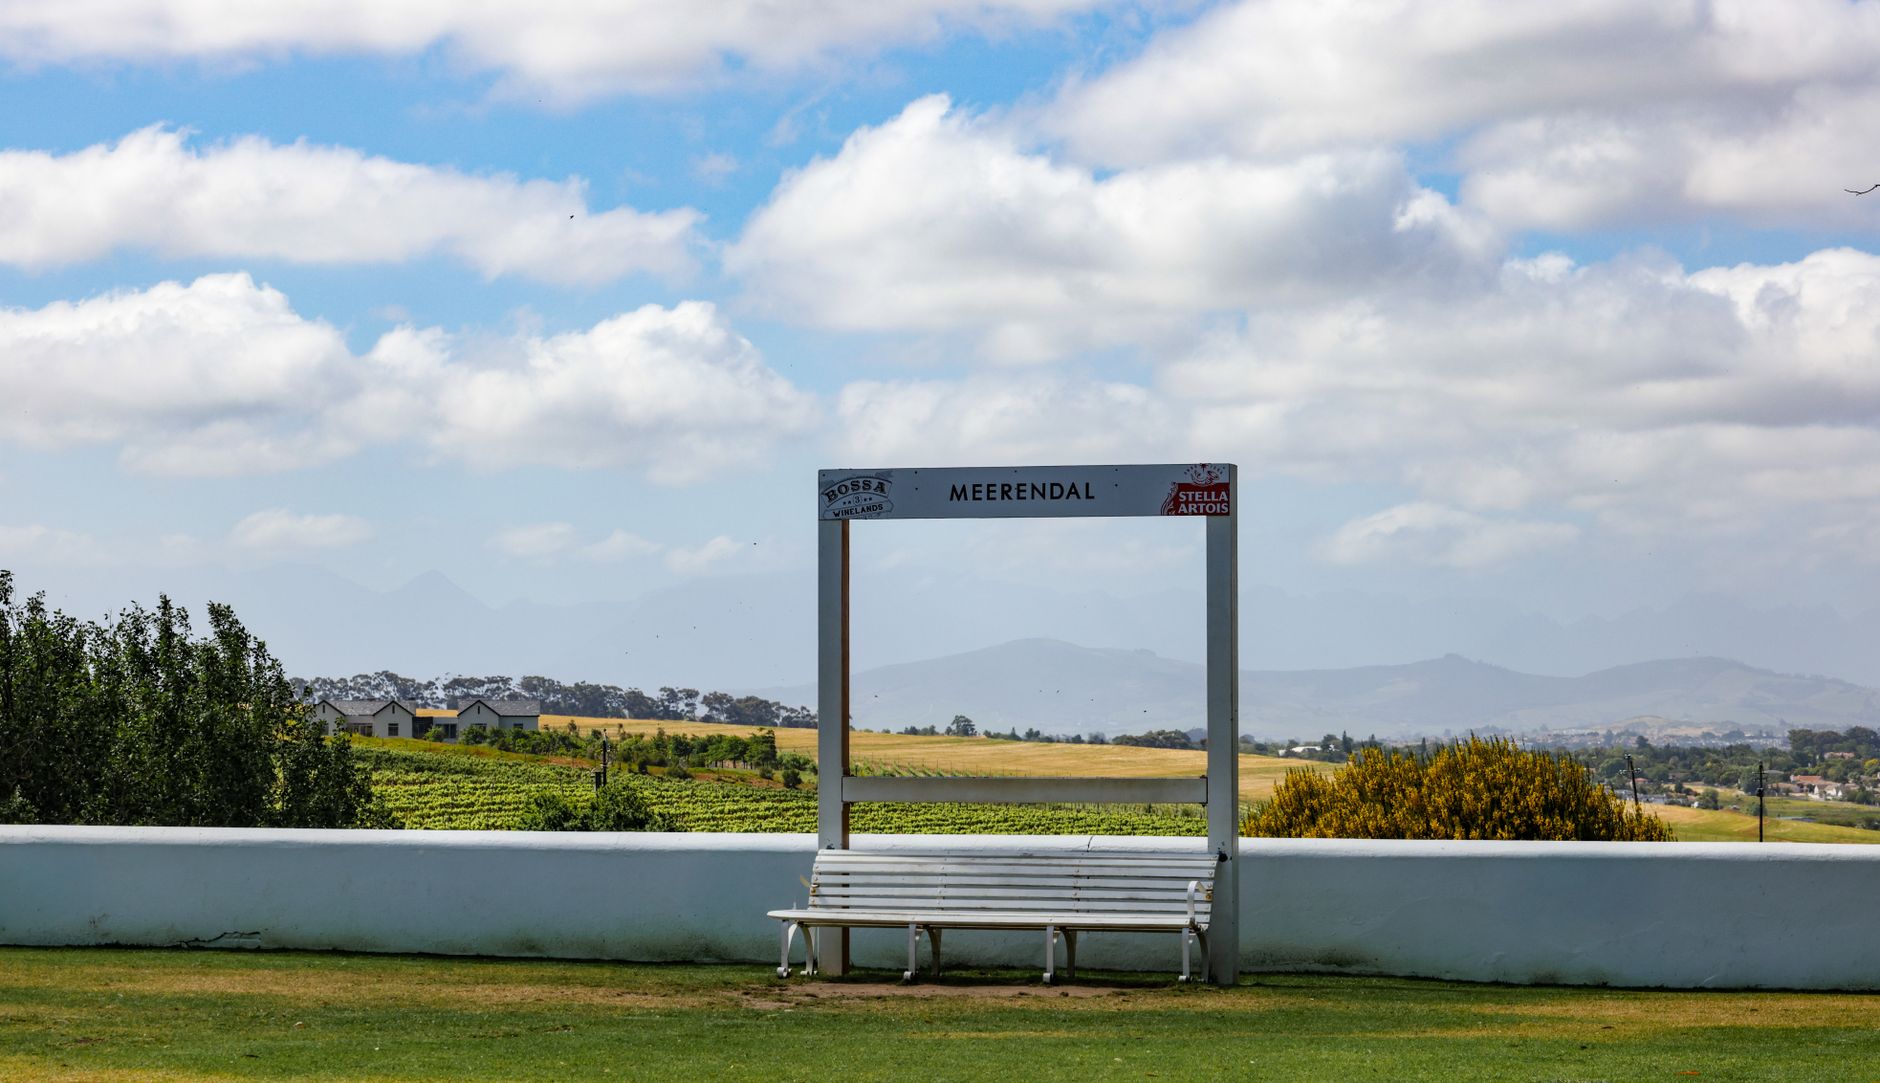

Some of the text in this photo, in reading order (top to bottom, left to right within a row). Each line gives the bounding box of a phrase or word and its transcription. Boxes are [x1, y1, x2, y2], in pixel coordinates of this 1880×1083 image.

[825, 479, 886, 503] BOSSA
[950, 482, 1095, 501] MEERENDAL
[1179, 491, 1228, 501] STELLA
[833, 504, 883, 517] WINELANDS
[1178, 503, 1229, 513] ARTOIS
